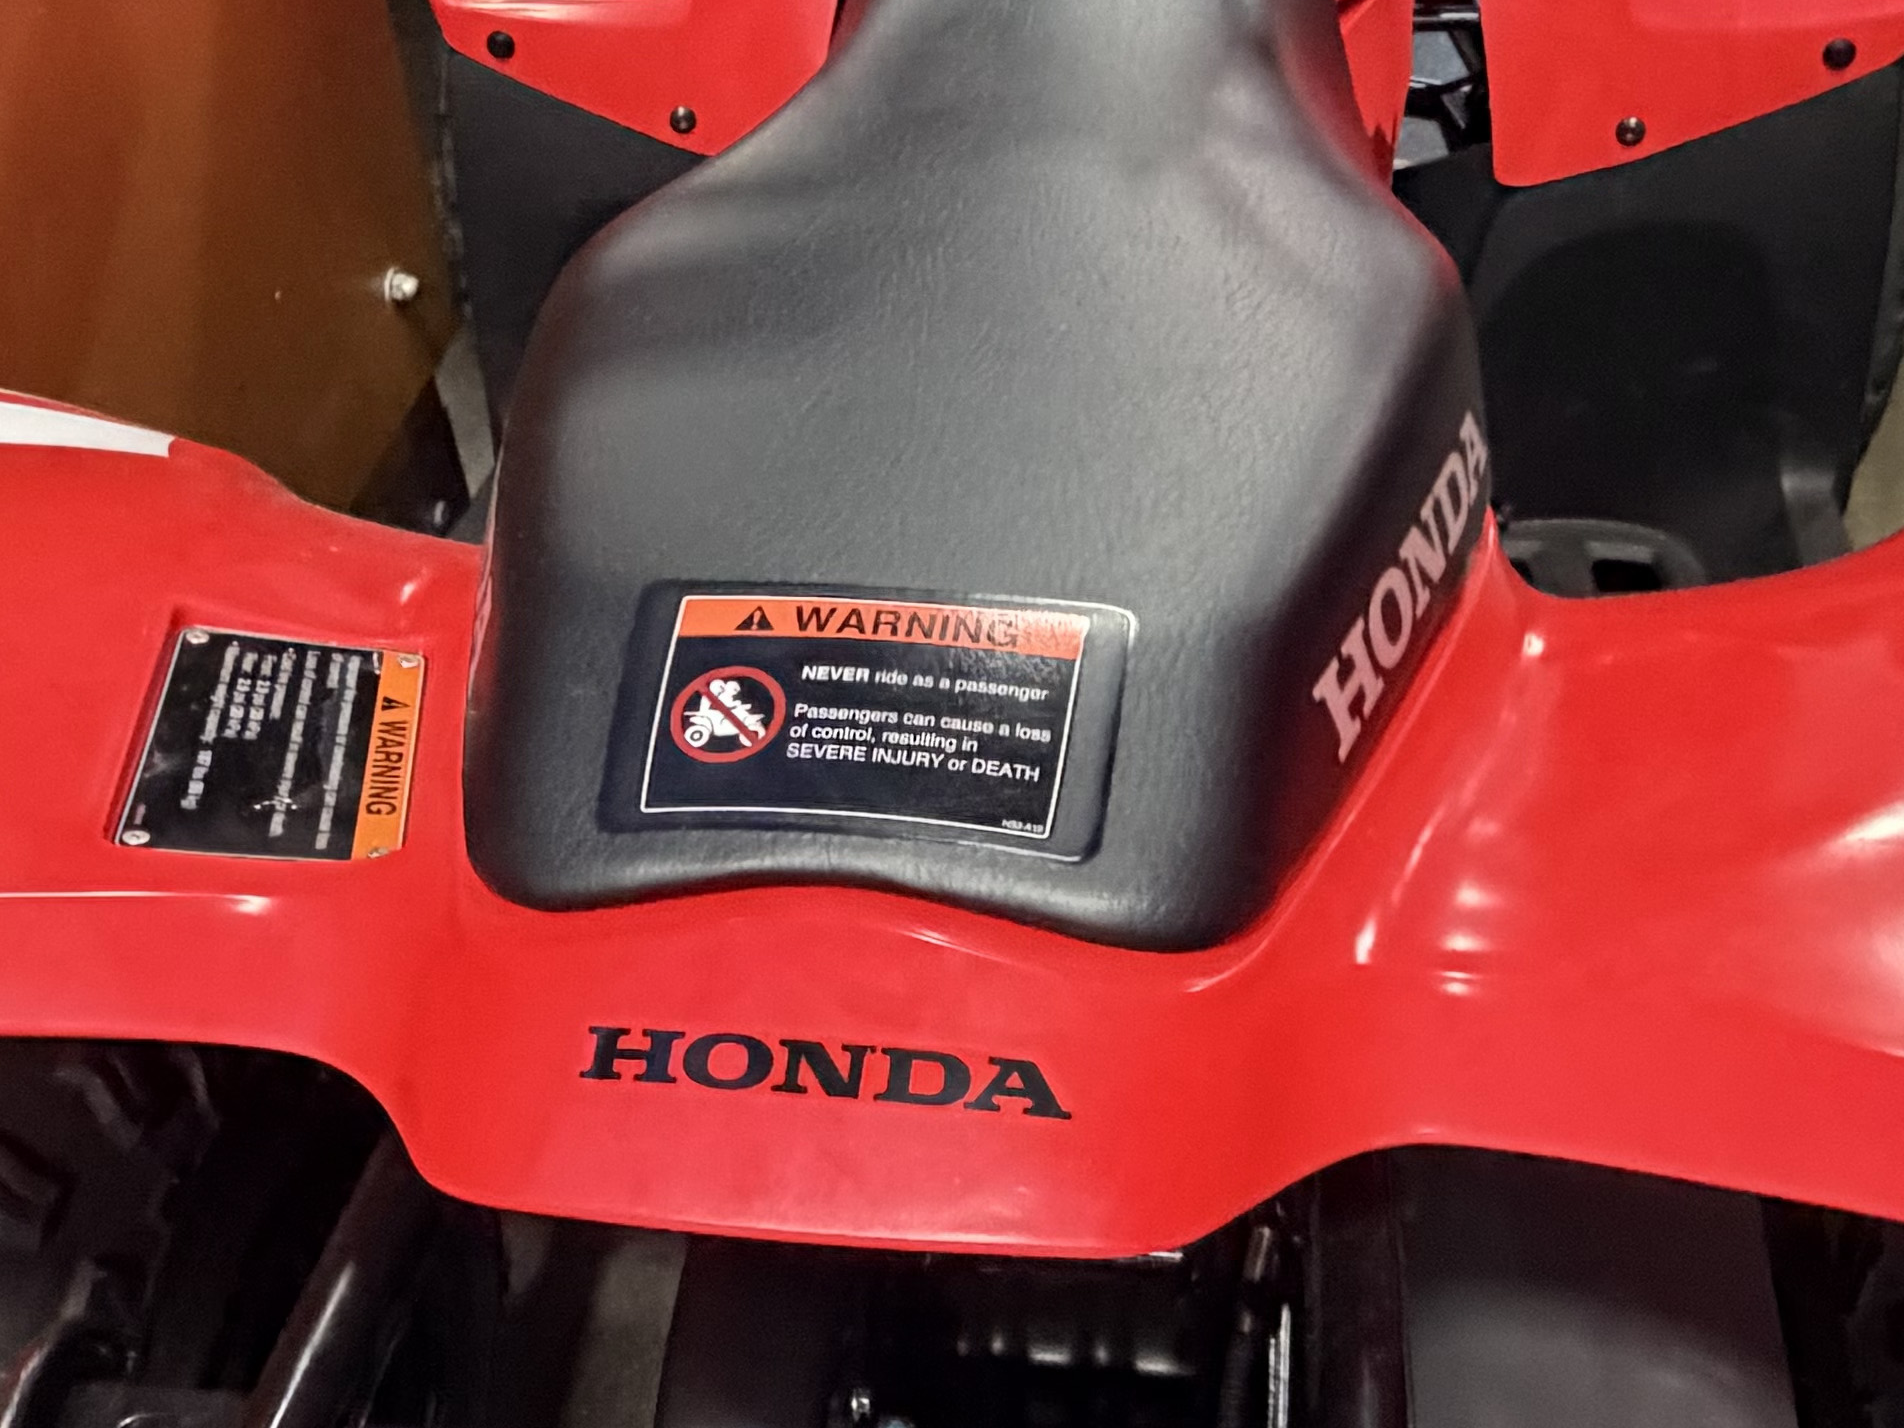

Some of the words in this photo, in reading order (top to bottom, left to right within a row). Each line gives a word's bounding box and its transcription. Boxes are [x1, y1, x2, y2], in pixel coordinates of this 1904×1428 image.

[1312, 410, 1488, 764] HONDA
[796, 605, 1019, 649] WARNING
[801, 665, 870, 682] NEVER
[875, 669, 908, 685] ride
[912, 674, 934, 689] as
[939, 677, 950, 690] a
[955, 678, 1049, 702] passenger
[790, 723, 806, 738] of
[811, 724, 876, 744] control,
[882, 731, 957, 753] resulting
[962, 735, 978, 752] in
[794, 703, 898, 724] Passengers
[903, 713, 935, 727] can
[940, 716, 994, 735] cause
[998, 723, 1010, 736] a
[1015, 722, 1052, 742] loss
[366, 720, 408, 815] WARNING
[786, 743, 868, 762] SEVERE
[872, 747, 945, 769] INJURY
[948, 758, 967, 771] or
[971, 758, 1040, 783] DEATH
[579, 1025, 1072, 1120] HONDA
